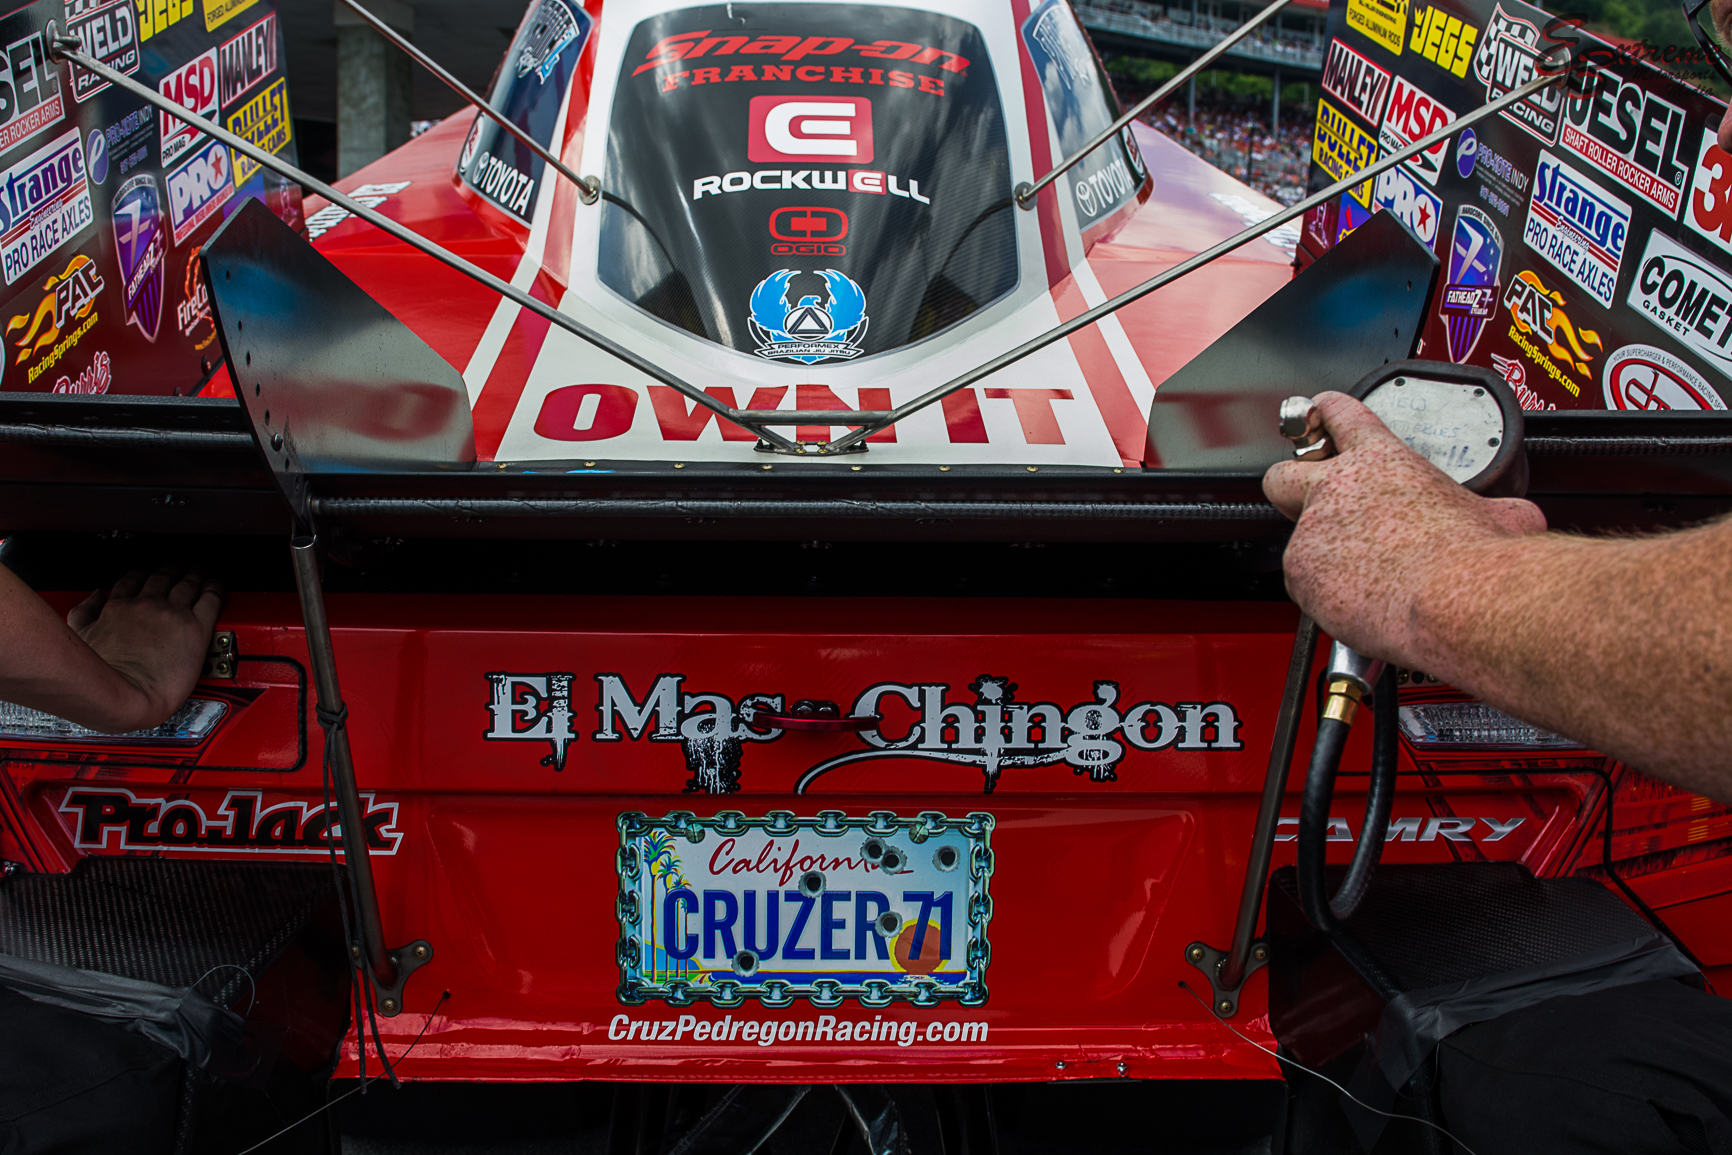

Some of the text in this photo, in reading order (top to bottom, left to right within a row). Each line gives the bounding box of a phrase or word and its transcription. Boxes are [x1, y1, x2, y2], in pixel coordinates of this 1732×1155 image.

[631, 29, 971, 78] Snap-on
[1409, 5, 1479, 79] JEGS
[162, 55, 215, 138] MSD
[661, 64, 946, 97] FRANCHISE
[10, 114, 40, 143] ROCKER
[40, 102, 61, 126] ARMS
[1386, 80, 1450, 155] MSD
[169, 144, 229, 226] PRO
[480, 156, 535, 217] TOYOTA
[693, 170, 931, 205] ROCKWELL
[1087, 157, 1136, 209] TOYOTA
[1511, 167, 1529, 193] INDY
[1564, 127, 1677, 210] SHAFT ROLLER ROCKER ARMS
[4, 195, 91, 282] PRO RACE AXLES
[1533, 161, 1626, 252] Strange
[770, 242, 846, 256] OGIO
[1525, 217, 1615, 302] PRO RACE AXLES
[28, 311, 99, 384] RacingSprings.com
[1642, 299, 1691, 337] GASKET
[1508, 324, 1581, 398] RacingSprings.com
[1626, 347, 1662, 361] SUPERCHARGER
[1664, 357, 1699, 388] PERFORMANCE
[533, 384, 1075, 446] OWN IT
[487, 673, 1243, 778] El Mas Chingon
[60, 786, 404, 856] Pro-Jack
[663, 888, 954, 962] CRUZER 71
[607, 1013, 990, 1047] CruzPedregonRacing.com
